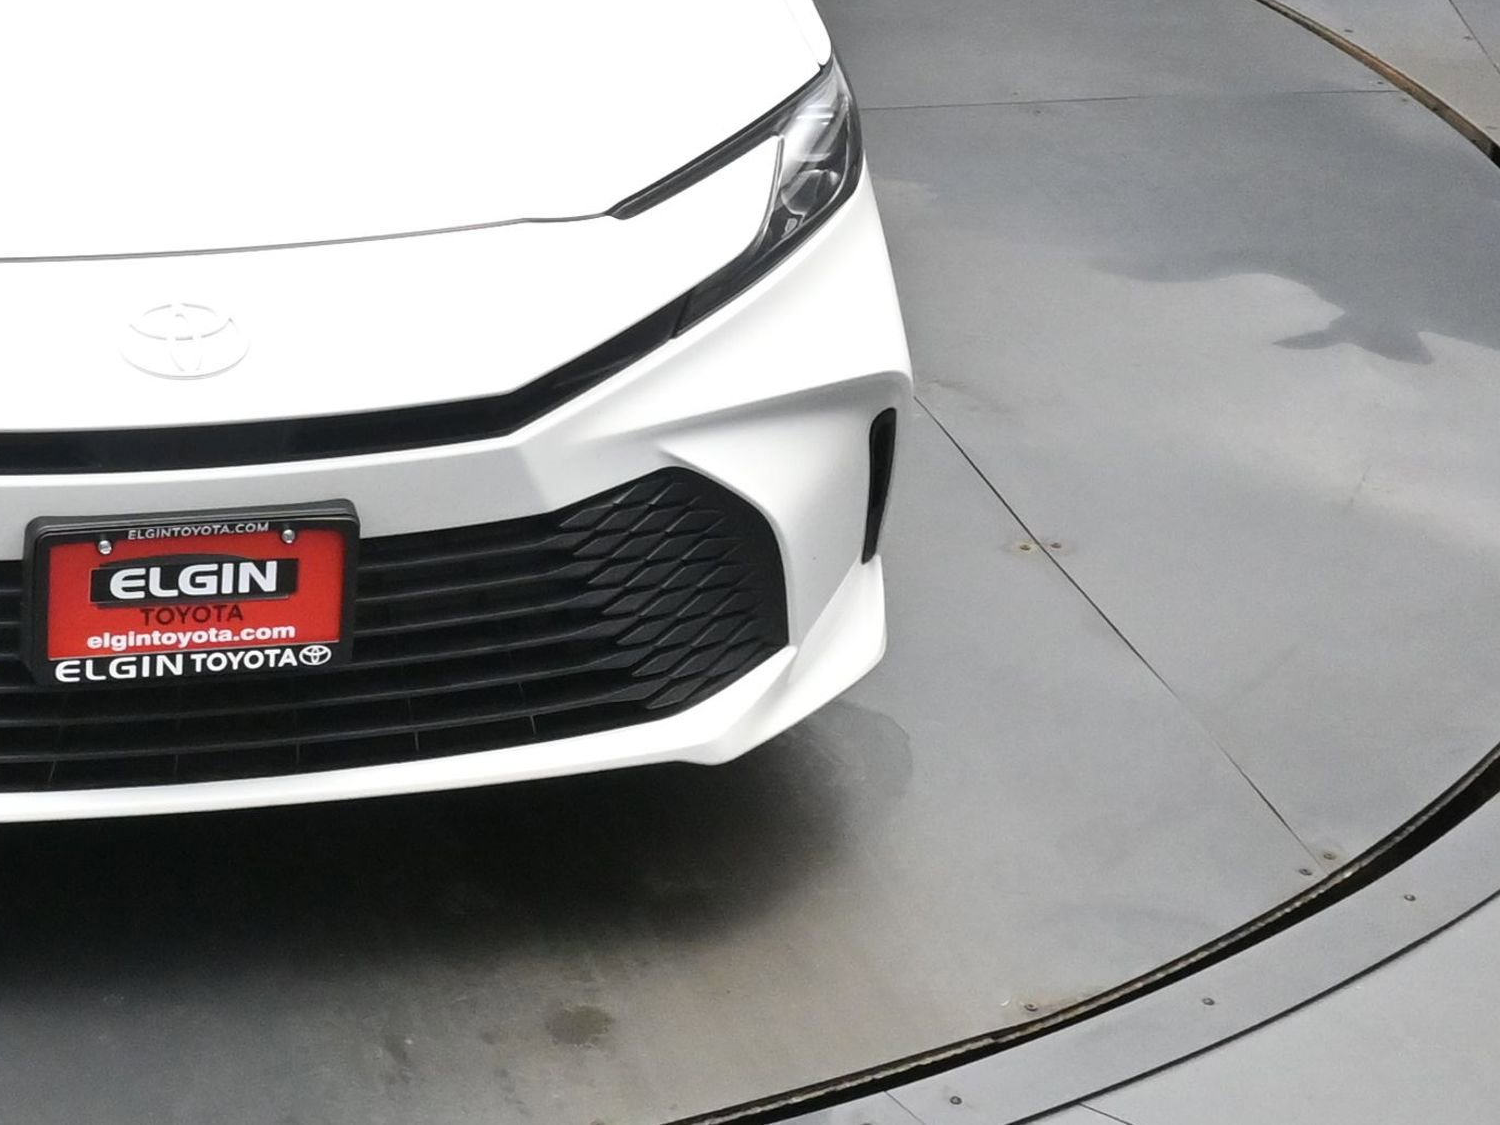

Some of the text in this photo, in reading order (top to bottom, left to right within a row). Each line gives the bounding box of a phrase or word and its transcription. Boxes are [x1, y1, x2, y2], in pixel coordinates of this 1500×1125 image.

[127, 522, 269, 540] ELGINTOYOTA.COM
[109, 561, 278, 600] ELGIN
[140, 605, 243, 625] TOYOTA
[87, 626, 296, 651] elgintoyota.com
[55, 649, 297, 683] ELGIN TOYOTA
